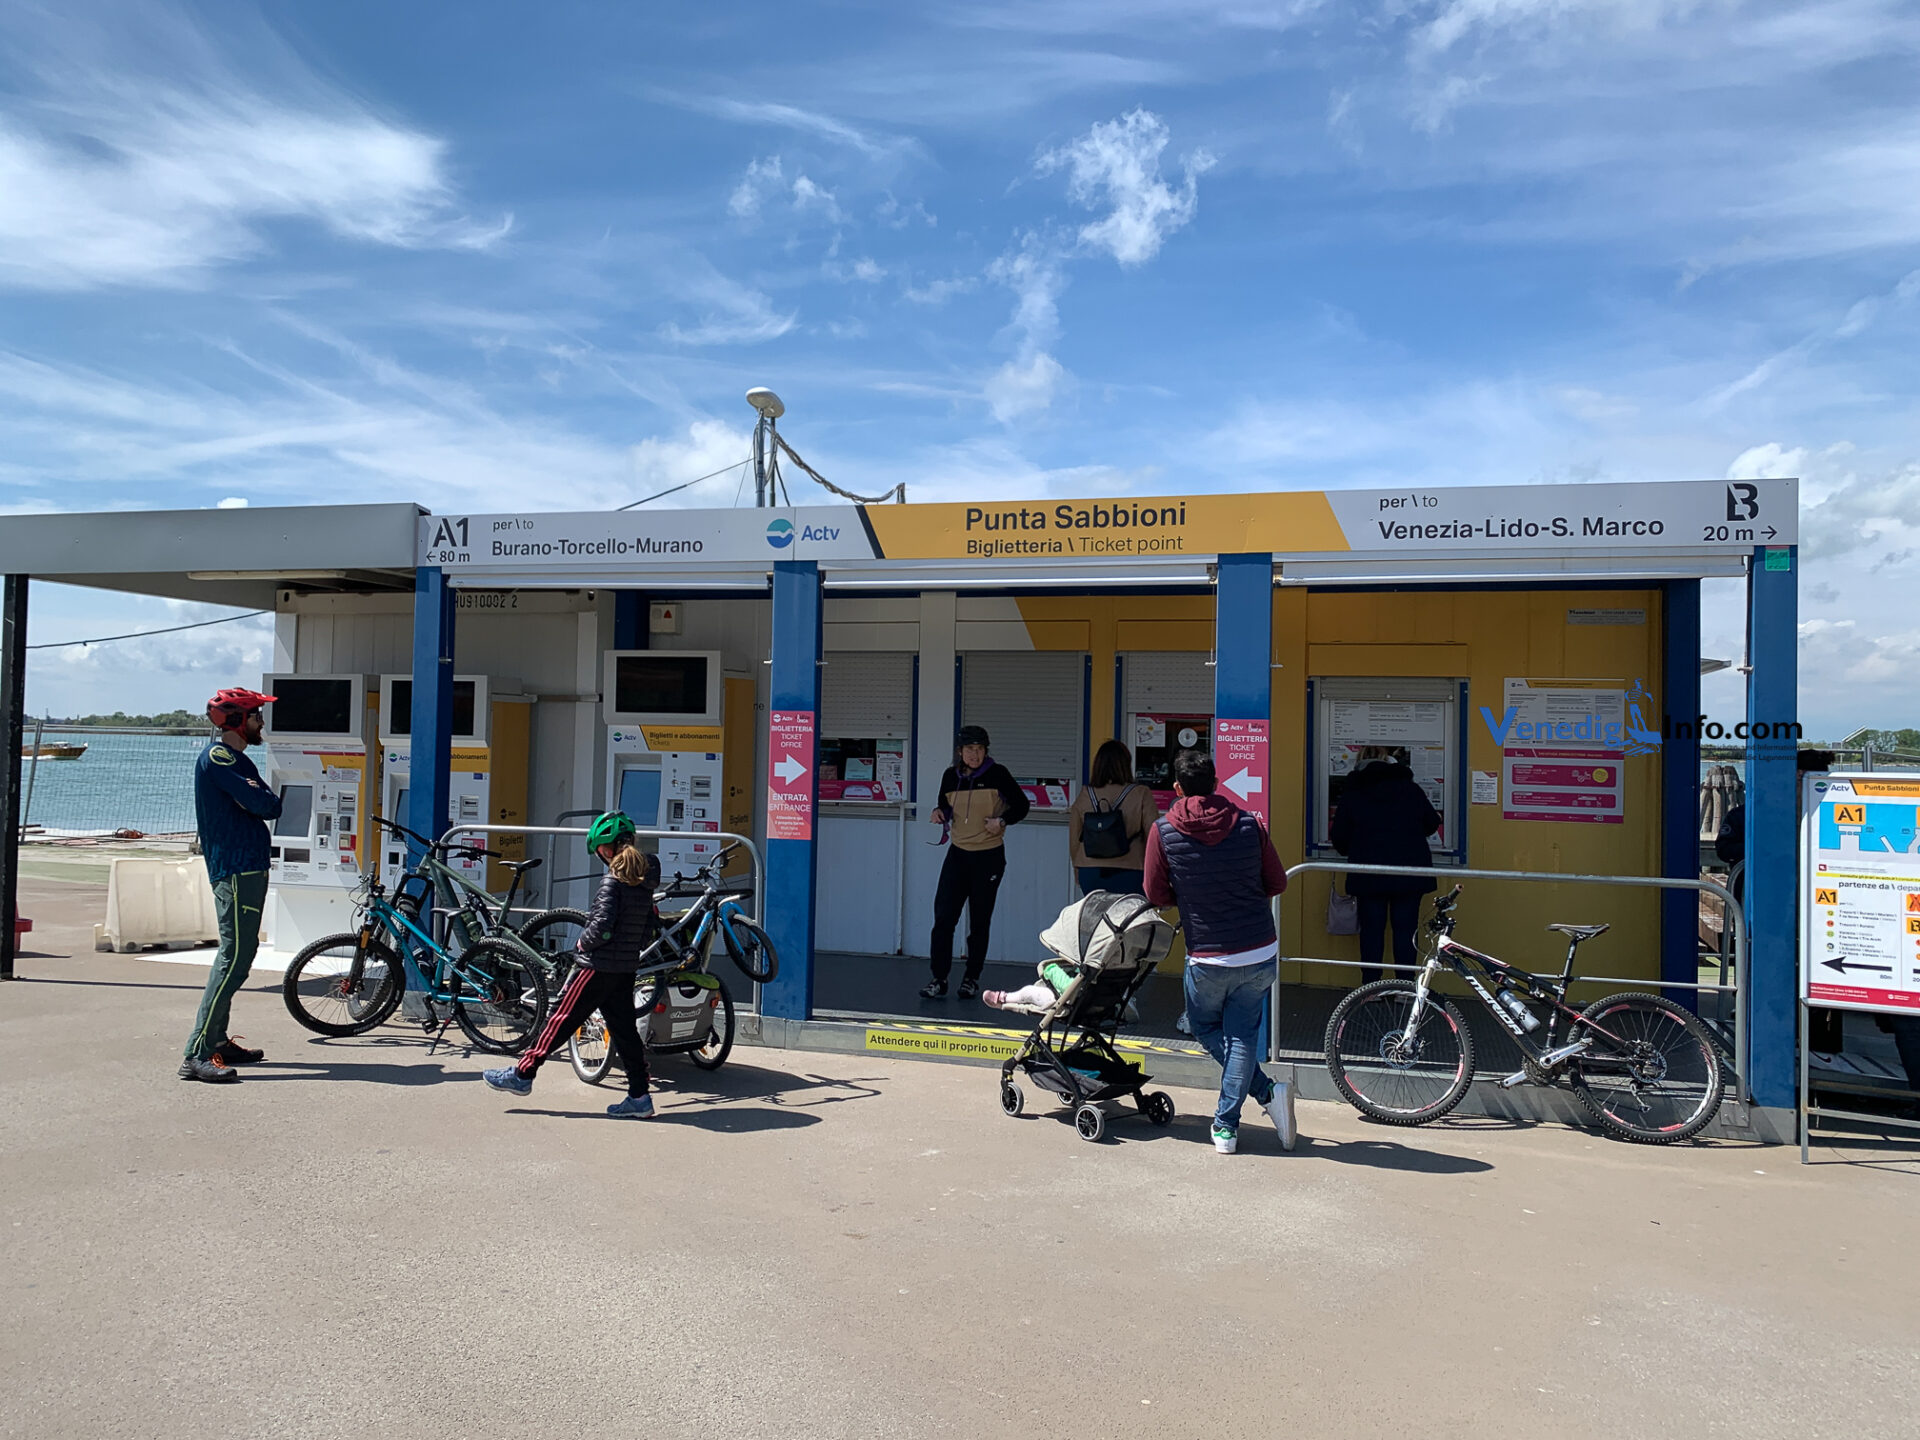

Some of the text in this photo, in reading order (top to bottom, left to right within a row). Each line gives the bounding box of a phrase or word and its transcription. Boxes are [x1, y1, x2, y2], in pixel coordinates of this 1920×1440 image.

[1379, 496, 1407, 512] per
[1422, 495, 1438, 508] to
[1726, 483, 1759, 522] B
[966, 501, 1187, 532] Punta Sabbioni
[432, 517, 469, 548] A1
[492, 520, 512, 533] per
[522, 518, 534, 530] to
[1378, 516, 1665, 541] Venezia-Lido-S. Marco
[801, 524, 841, 542] Actv
[1703, 525, 1755, 542] 20 m
[491, 537, 704, 557] Burano-Torcello-Murano
[966, 536, 1063, 558] Biglietteria
[1078, 535, 1133, 553] Ticket
[1137, 535, 1184, 556] point
[439, 550, 471, 563] 80 m
[649, 731, 673, 740] Biglietti
[679, 731, 720, 740] abbonamenti
[771, 725, 813, 733] BIGLIETTERIA
[780, 741, 803, 749] OFFICE
[1217, 735, 1268, 743] BIGLIETTERIA
[1229, 743, 1256, 751] TICKET
[1229, 752, 1256, 760] OFFICE
[1830, 784, 1850, 792] Actv
[1863, 784, 1920, 793] Punta Sabbioni
[772, 793, 808, 802] ENTRATA
[768, 803, 811, 812] ENTRANCE
[1837, 806, 1863, 822] A1
[1838, 881, 1877, 891] partenze
[1878, 881, 1890, 890] da
[1817, 890, 1837, 904] A1
[870, 1034, 1018, 1057] Attendere qui il proprio turno
